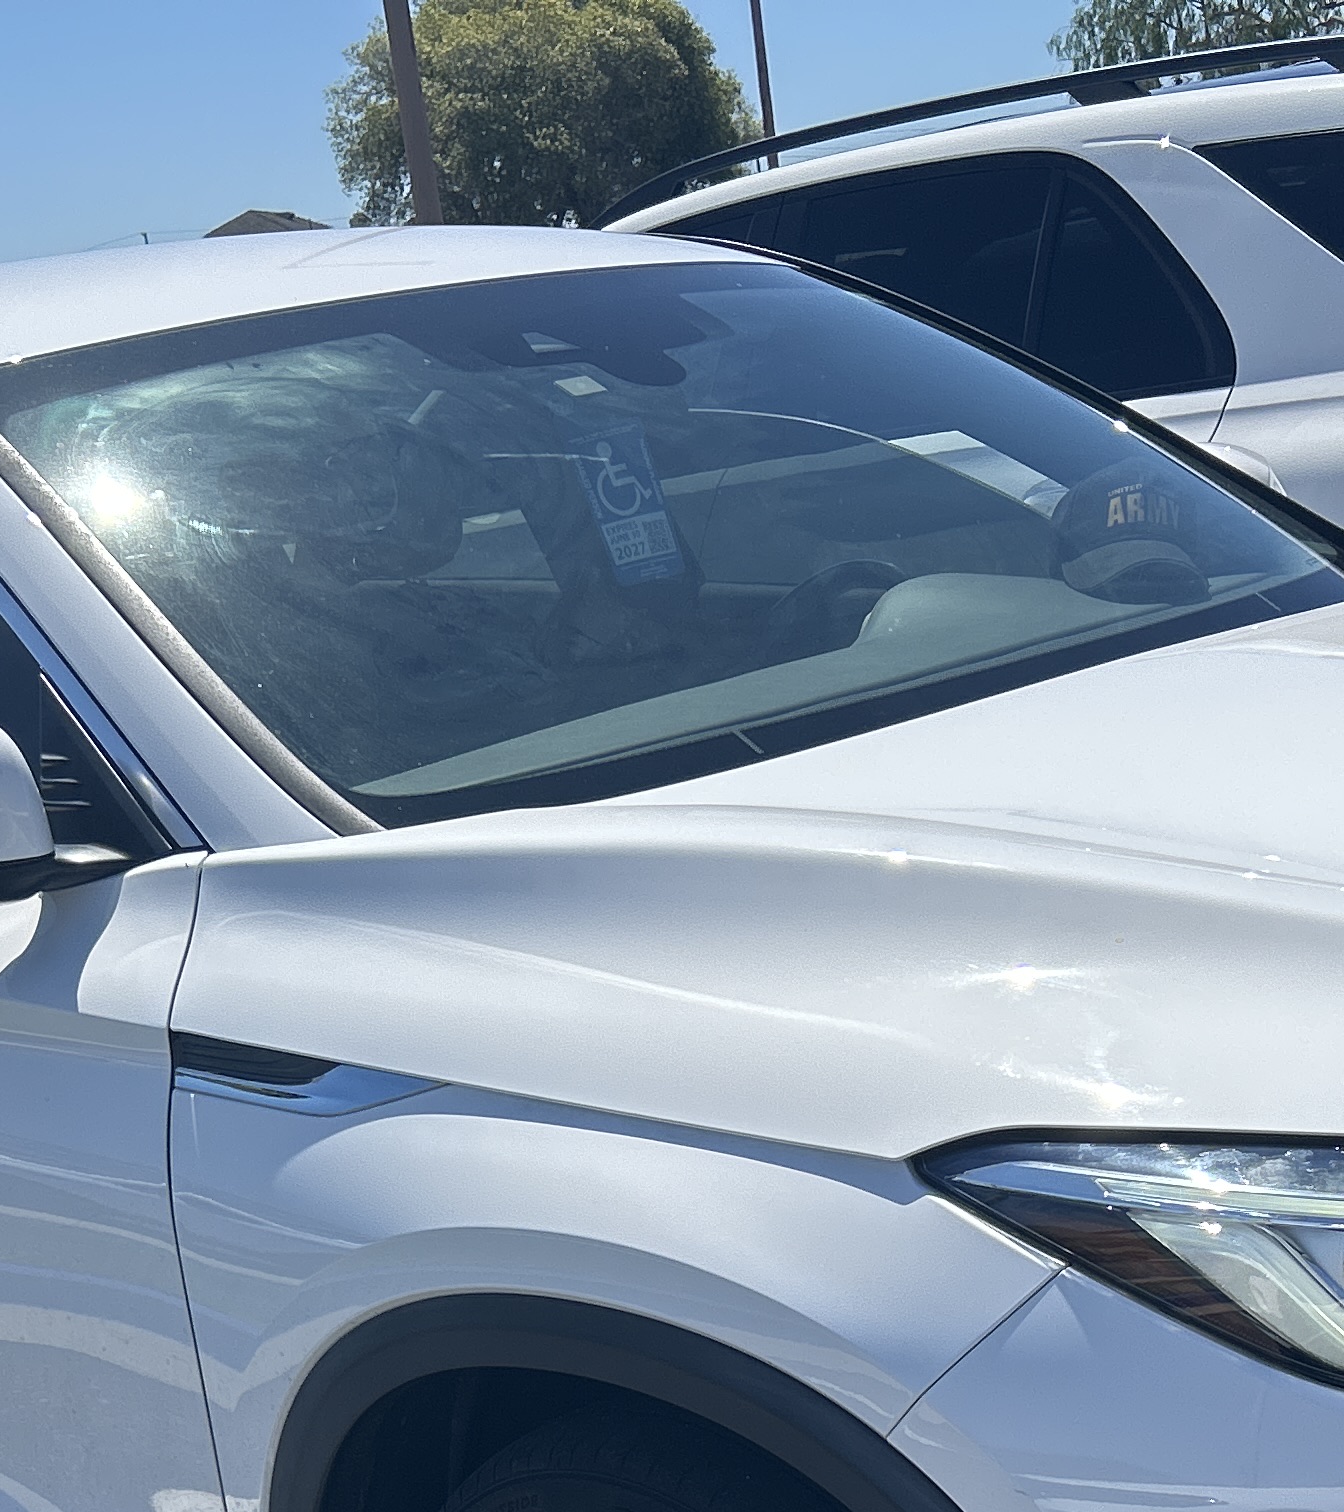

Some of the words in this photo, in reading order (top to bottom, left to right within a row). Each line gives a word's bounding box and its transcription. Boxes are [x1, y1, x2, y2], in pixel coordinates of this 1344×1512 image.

[1107, 483, 1143, 497] UNITED
[1106, 493, 1180, 530] ARMY
[613, 541, 645, 561] 2027
